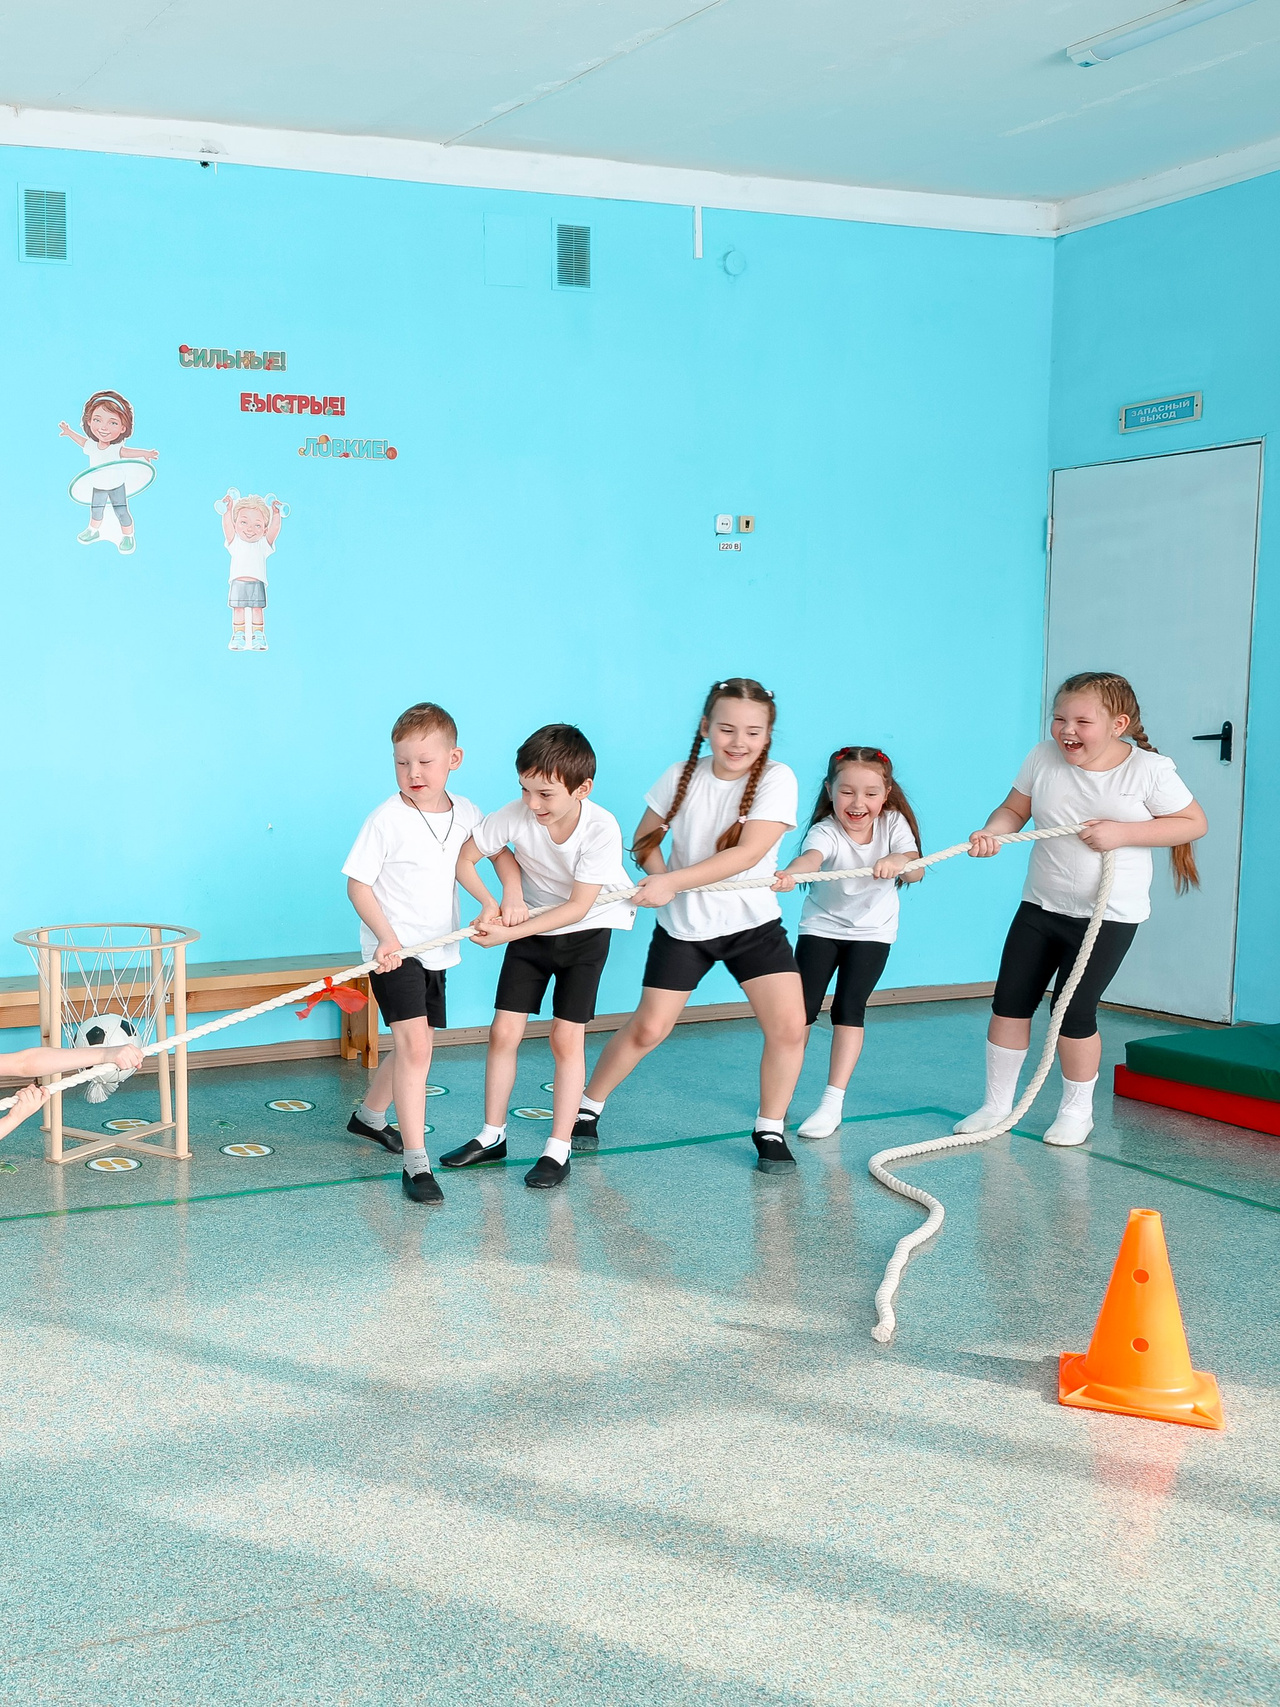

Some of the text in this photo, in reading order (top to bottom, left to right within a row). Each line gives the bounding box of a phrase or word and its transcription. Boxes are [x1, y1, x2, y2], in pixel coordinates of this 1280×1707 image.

[179, 347, 287, 371] СИЛЬНЫЕ!
[240, 392, 346, 416] БЫСТРЫЕ!
[1131, 400, 1190, 417] ЗАПАСНЫЙ
[1140, 411, 1177, 423] ВЫХОД
[304, 437, 389, 459] ЛОВКИЕ!
